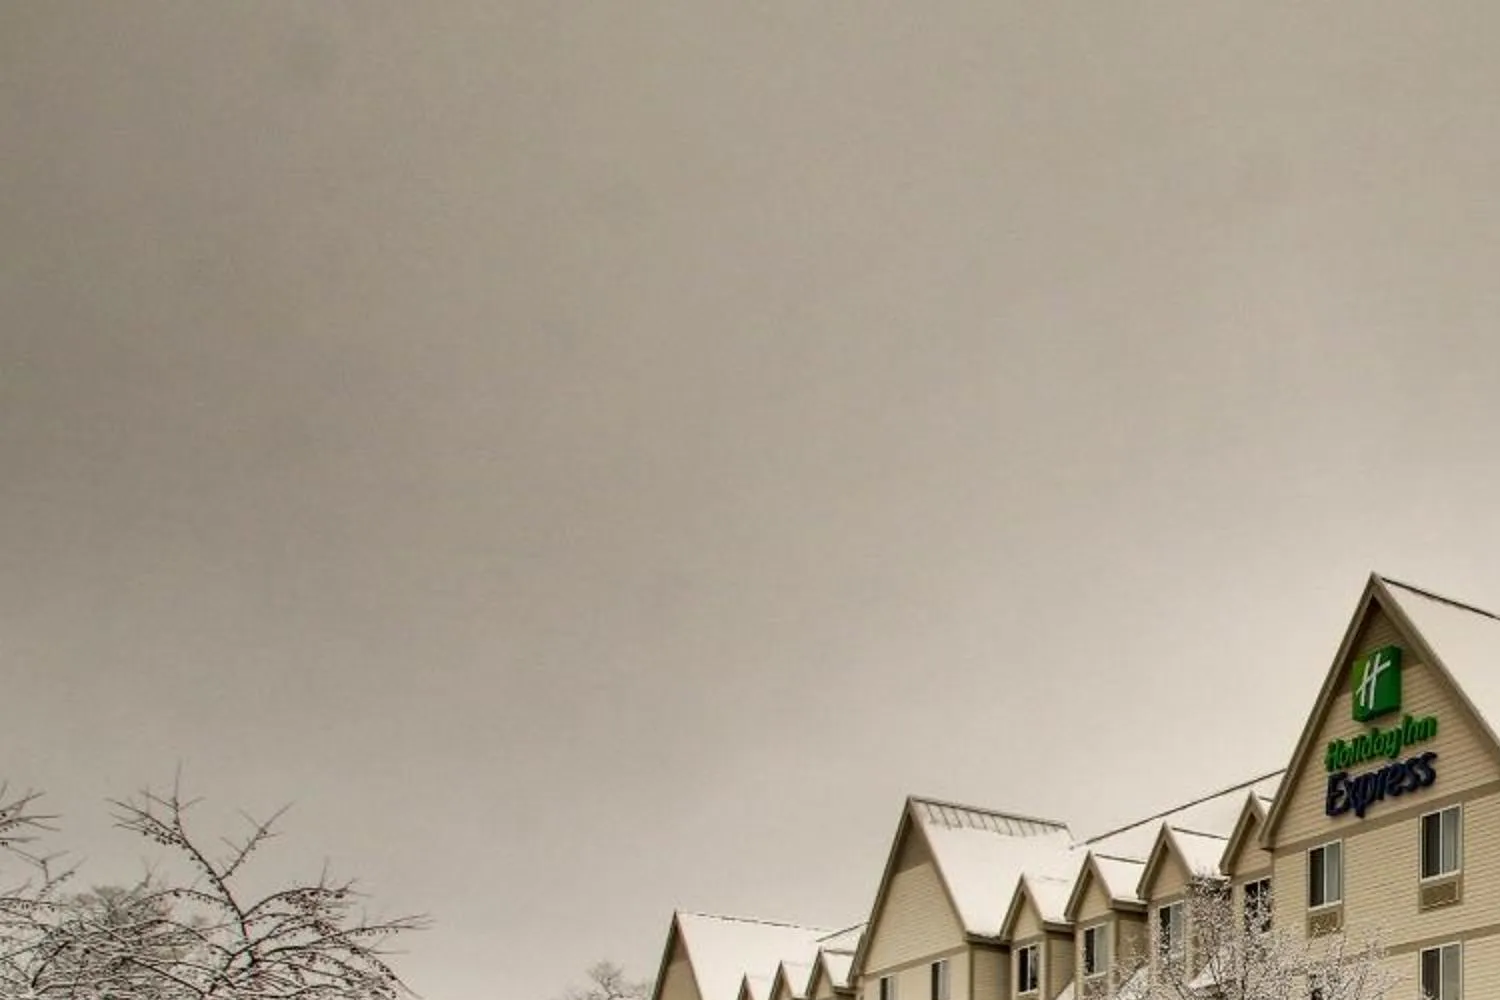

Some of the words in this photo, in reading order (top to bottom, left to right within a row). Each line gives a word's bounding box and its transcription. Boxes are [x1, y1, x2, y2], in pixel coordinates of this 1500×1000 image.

[1355, 652, 1392, 710] H
[1324, 727, 1402, 772] Holiday
[1401, 712, 1438, 747] Inn
[1325, 751, 1438, 818] Express
